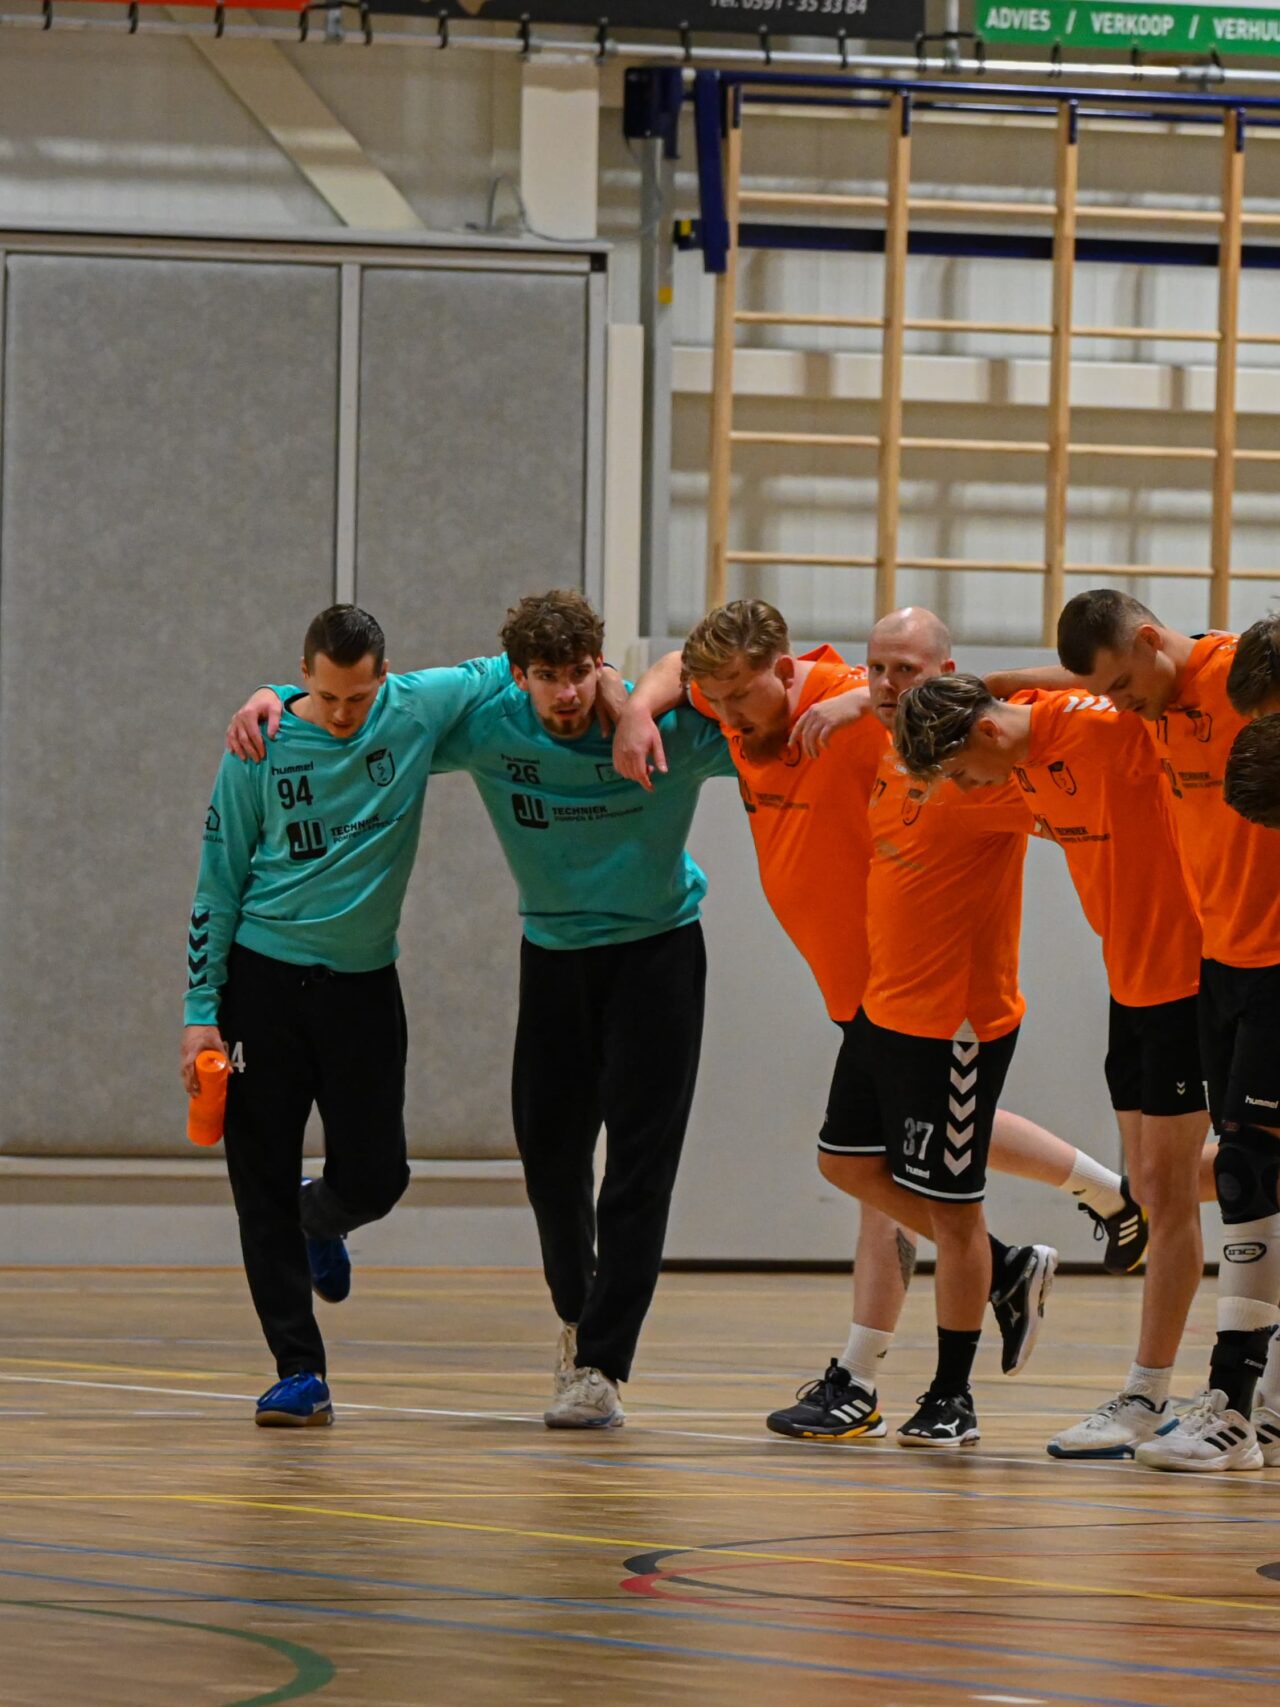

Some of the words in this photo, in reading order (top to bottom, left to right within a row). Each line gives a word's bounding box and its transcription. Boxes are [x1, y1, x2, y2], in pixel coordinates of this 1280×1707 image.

[796, 0, 818, 12] 35
[820, 0, 842, 14] 33
[844, 0, 867, 14] 84
[985, 7, 1051, 31] ADVIES
[1090, 11, 1174, 36] VERKOOP
[271, 761, 314, 776] hummel
[506, 762, 543, 785] 26
[277, 775, 314, 810] 94
[552, 804, 608, 816] TECHNIEK
[1245, 1095, 1279, 1109] hummel
[903, 1117, 934, 1160] 37
